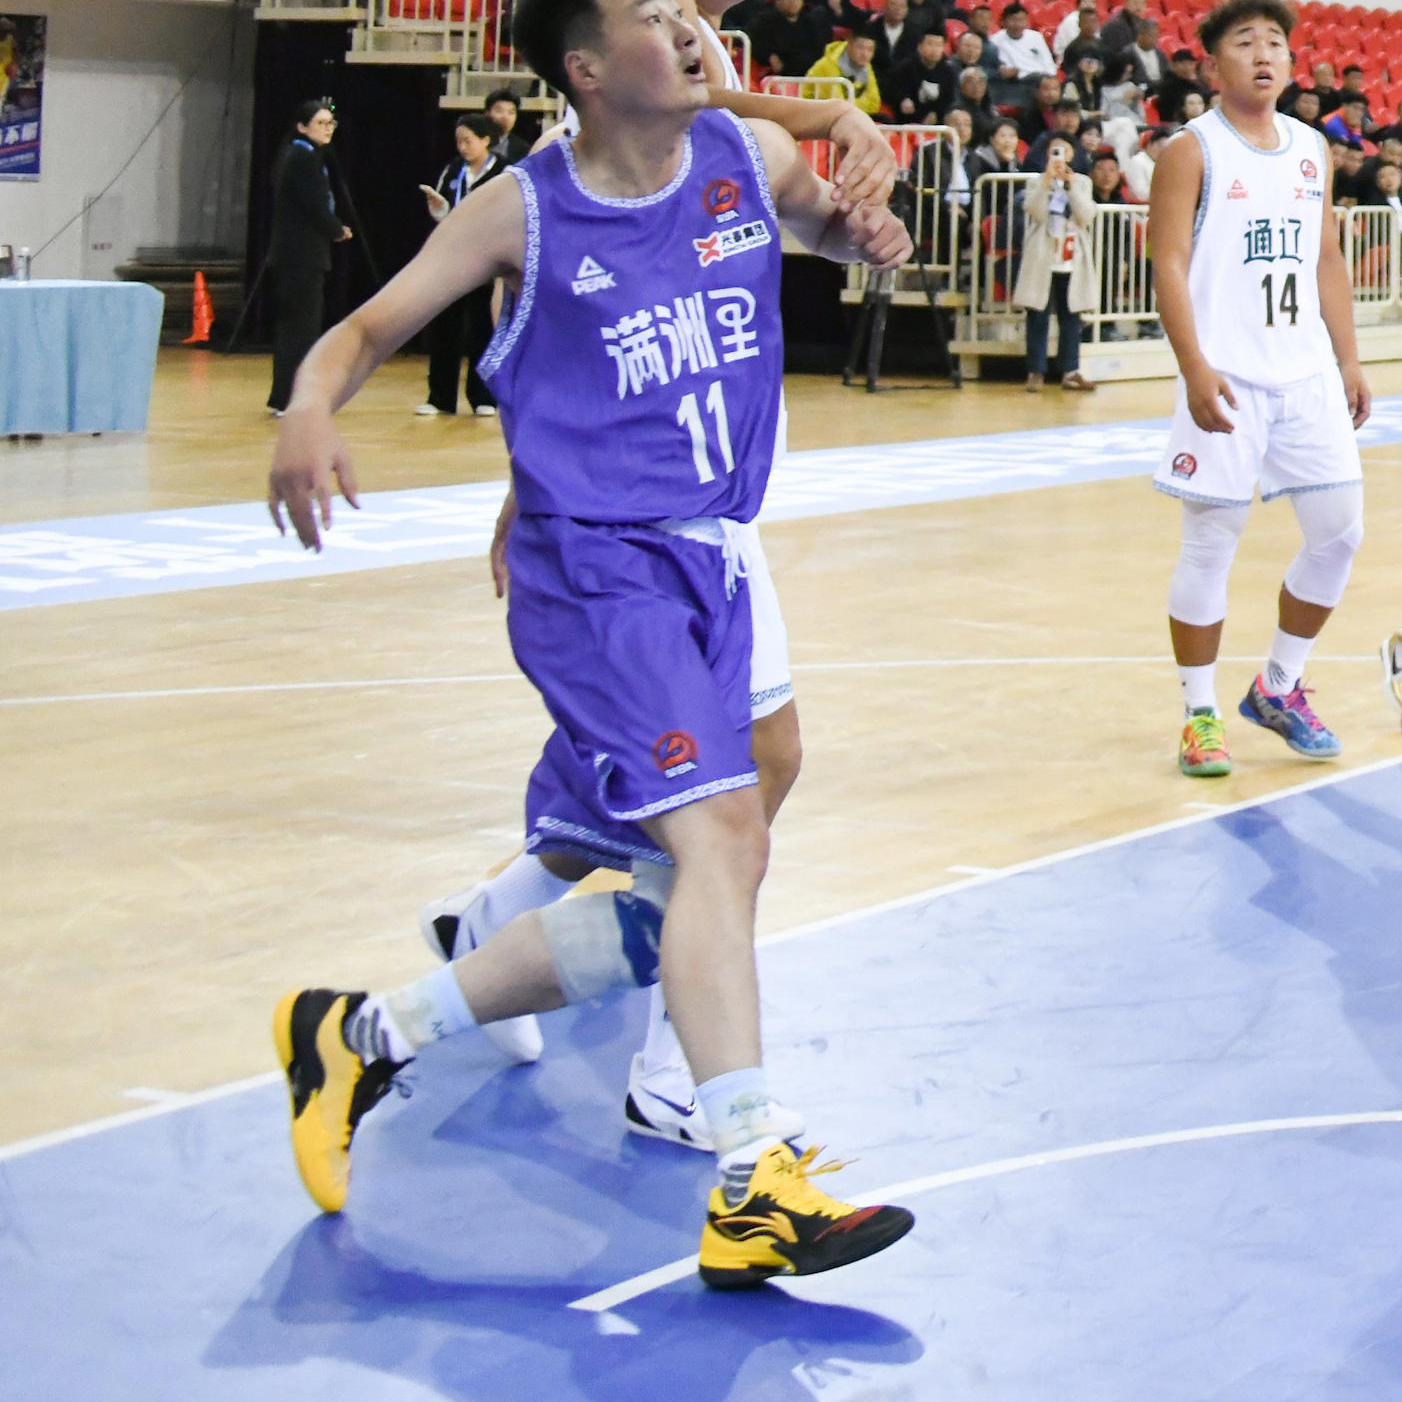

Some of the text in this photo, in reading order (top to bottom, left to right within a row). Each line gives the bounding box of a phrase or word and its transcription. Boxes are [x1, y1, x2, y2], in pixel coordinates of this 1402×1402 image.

[1243, 218, 1304, 264] 通辽
[572, 272, 616, 296] PEAK
[1260, 273, 1300, 327] 14
[600, 286, 761, 401] 满洲里
[675, 380, 736, 485] 11
